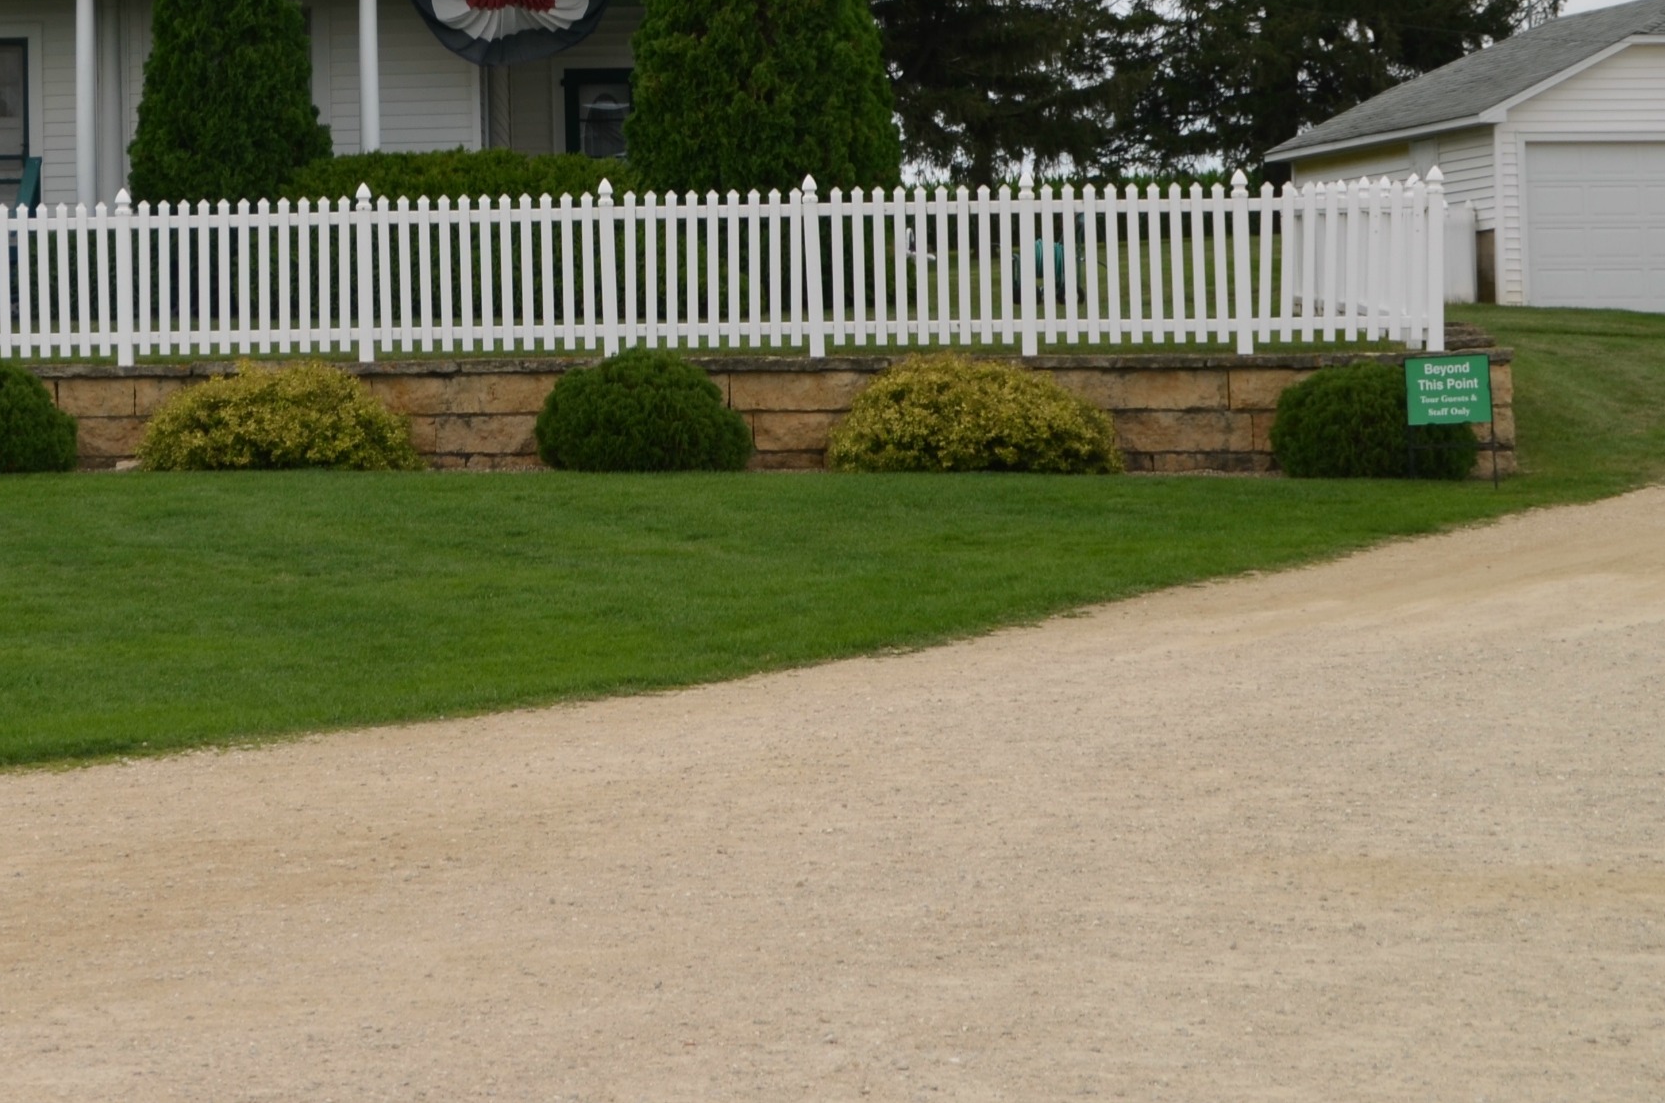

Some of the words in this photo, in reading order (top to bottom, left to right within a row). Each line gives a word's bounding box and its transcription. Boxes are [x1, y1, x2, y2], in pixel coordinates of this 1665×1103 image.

[1424, 362, 1470, 376] Beyond
[1418, 379, 1444, 391] This
[1447, 378, 1478, 389] Point
[1420, 395, 1439, 404] Tour
[1441, 394, 1469, 403] Guests
[1428, 407, 1448, 416] Staff
[1450, 407, 1470, 416] Only
